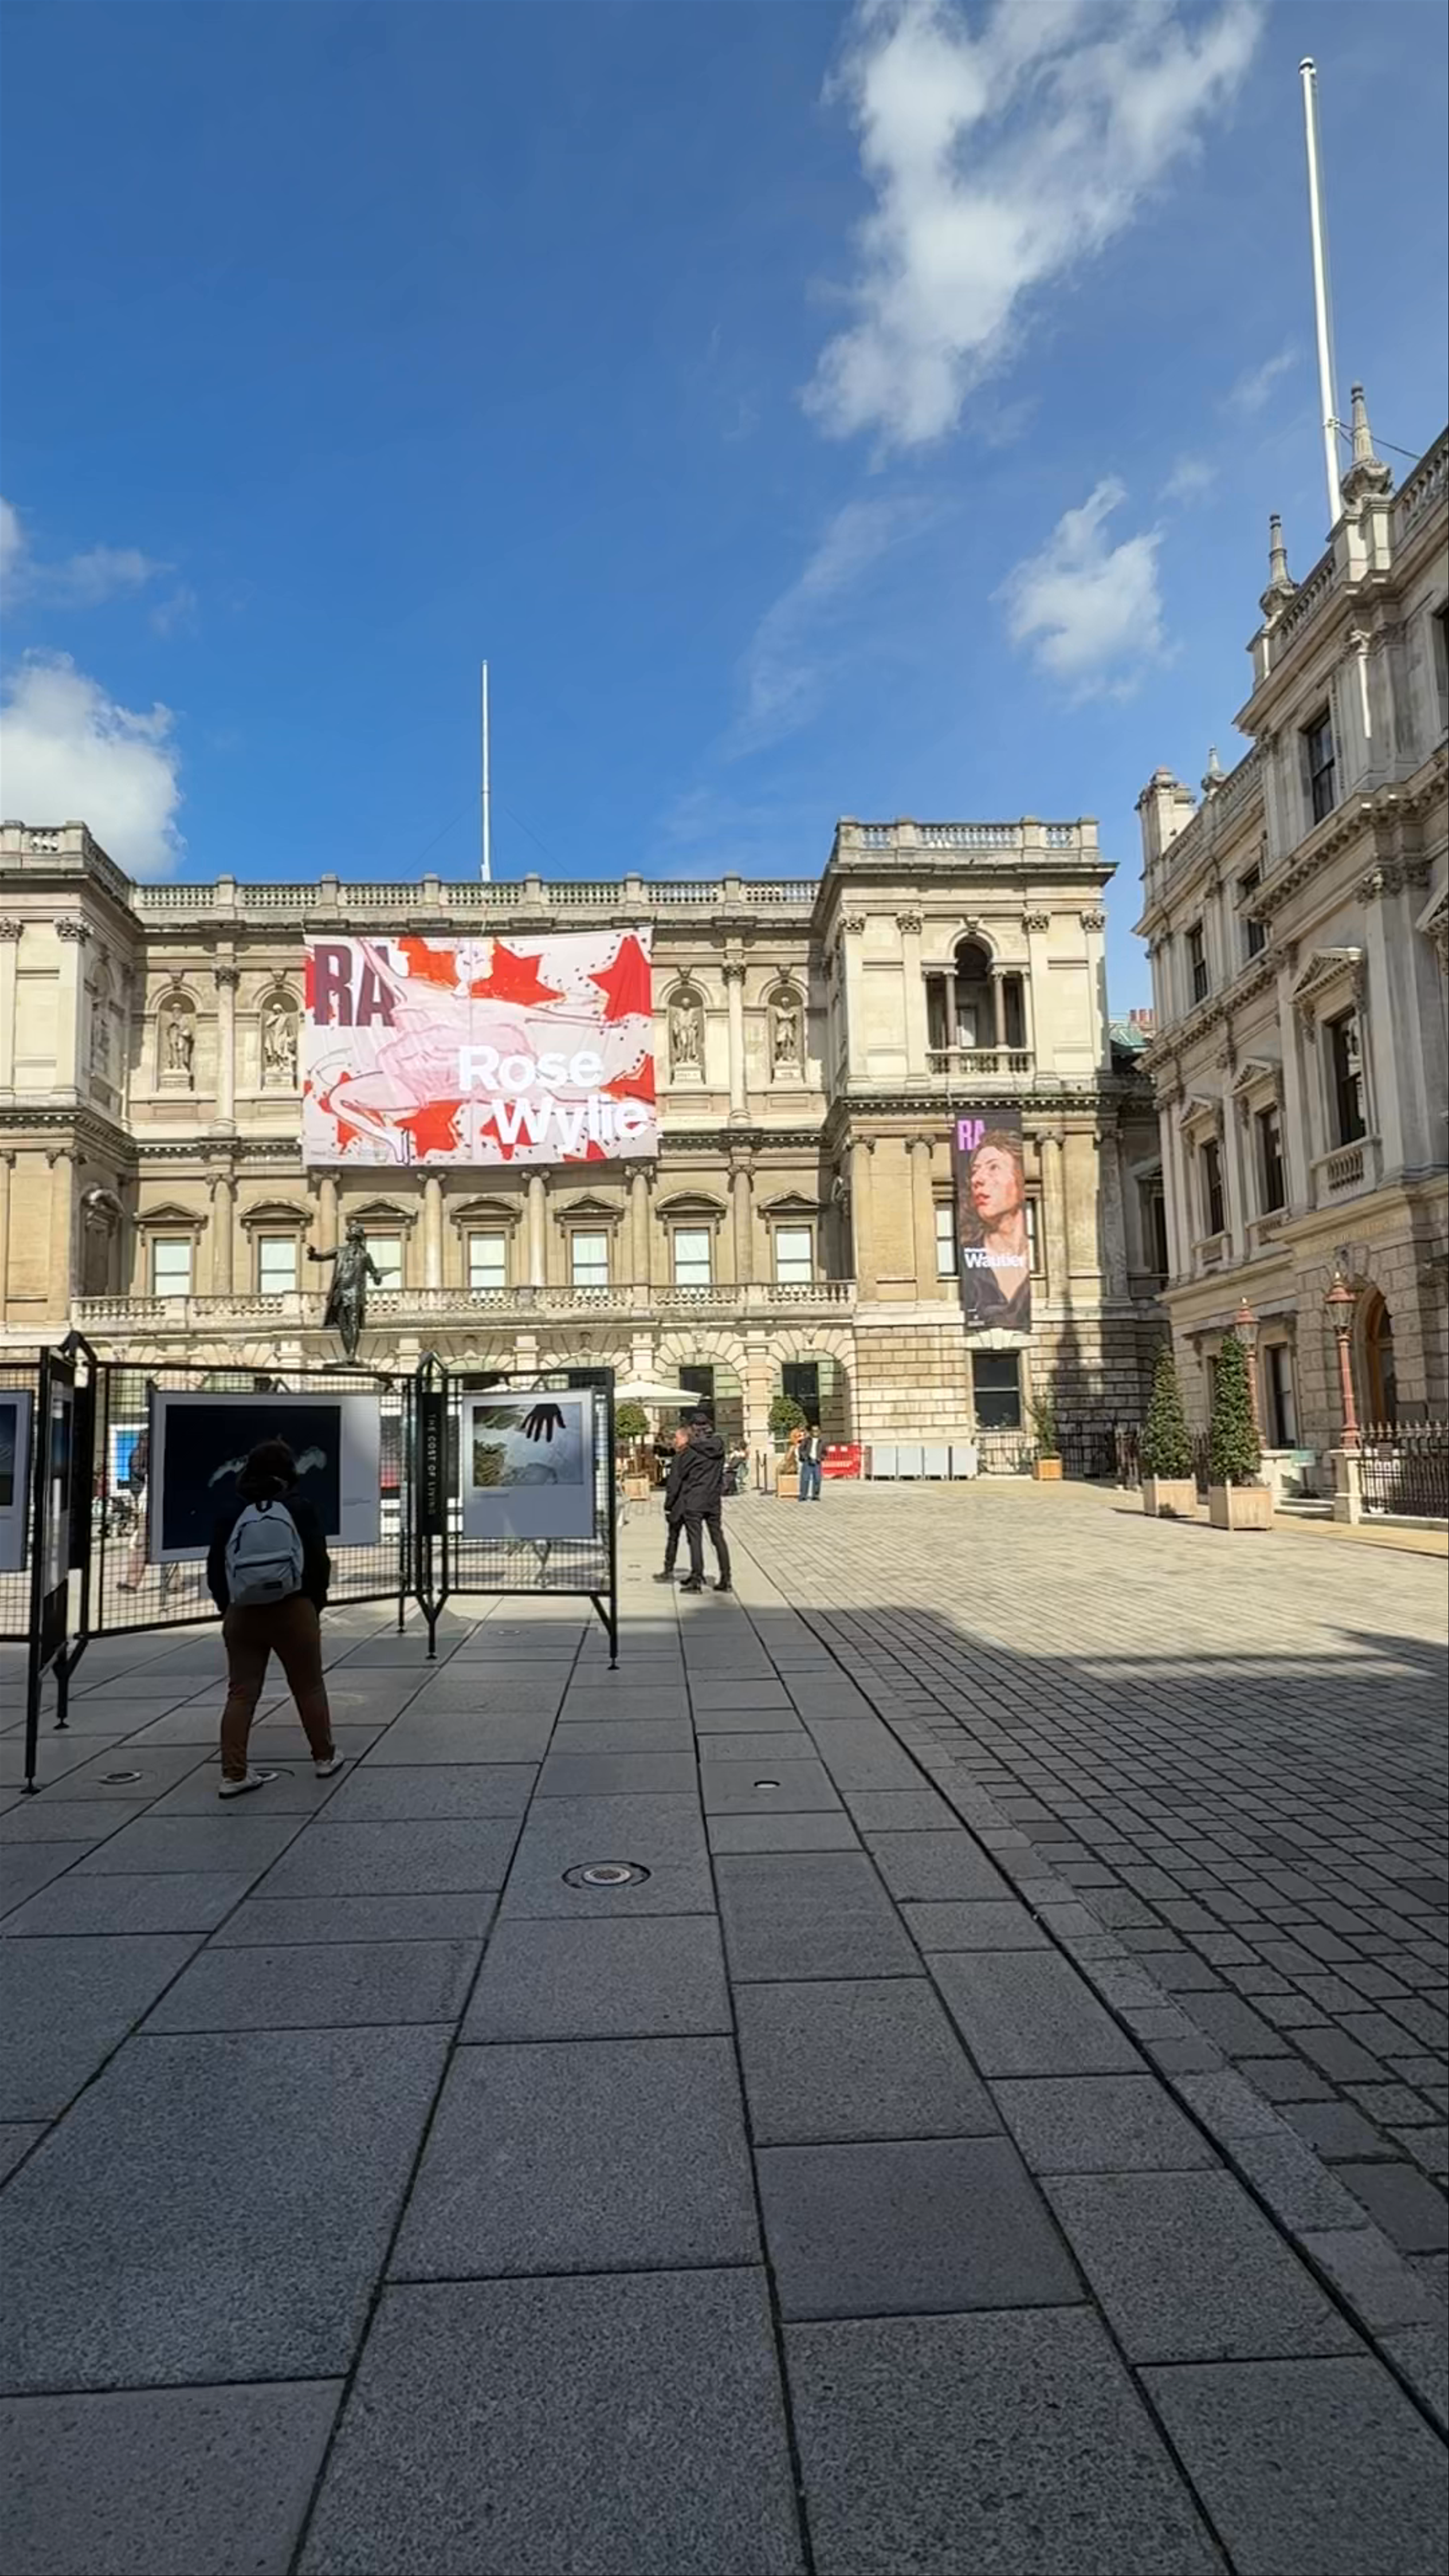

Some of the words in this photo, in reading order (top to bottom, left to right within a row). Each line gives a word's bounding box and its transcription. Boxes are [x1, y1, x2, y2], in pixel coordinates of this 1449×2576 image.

[314, 944, 395, 1026] RA
[458, 1044, 603, 1092] Rose
[491, 1093, 649, 1154] Wylie
[428, 1413, 436, 1431] THE
[428, 1435, 436, 1461] COST
[428, 1464, 436, 1476] OF
